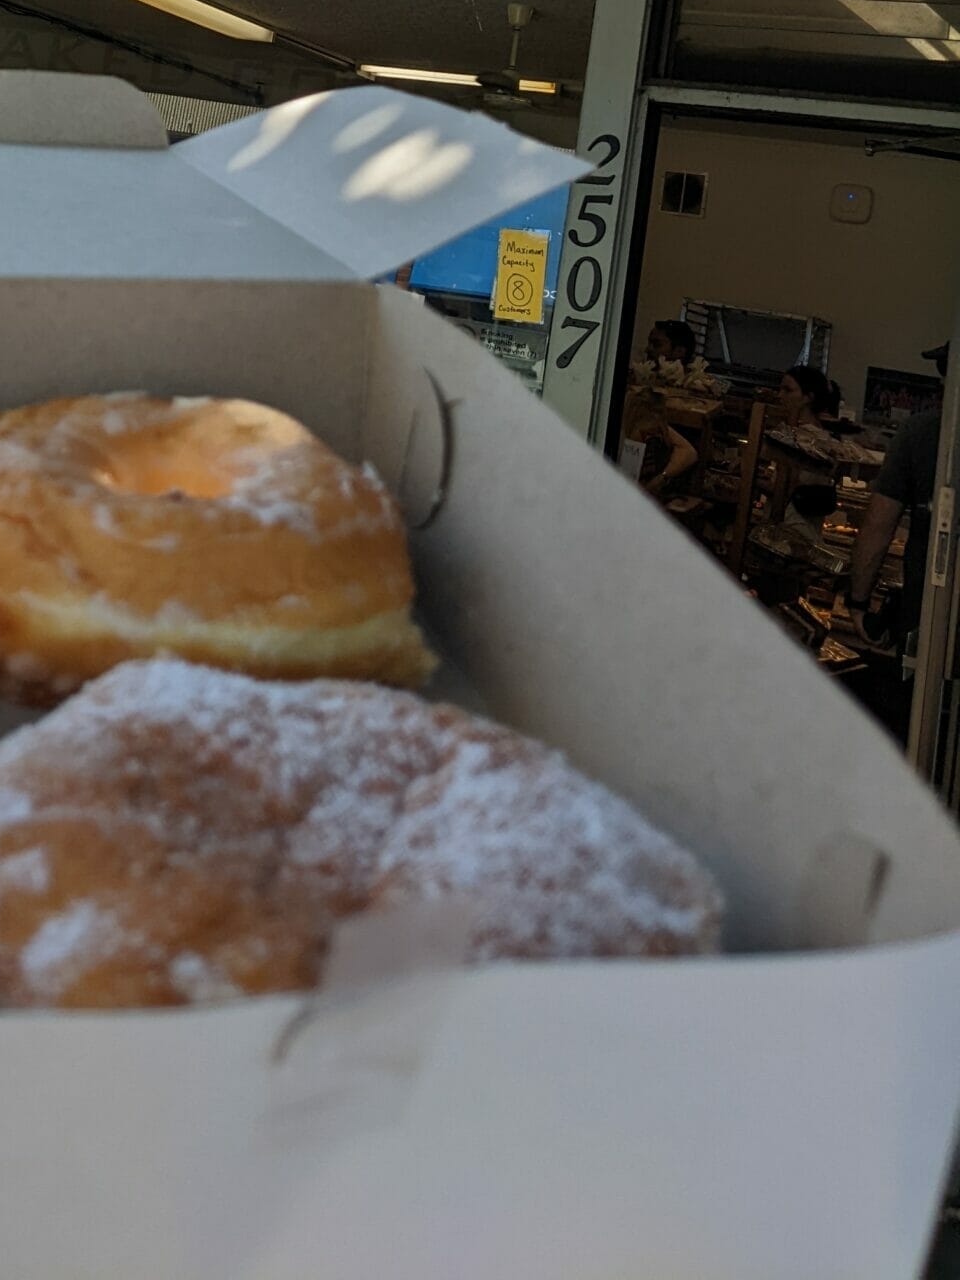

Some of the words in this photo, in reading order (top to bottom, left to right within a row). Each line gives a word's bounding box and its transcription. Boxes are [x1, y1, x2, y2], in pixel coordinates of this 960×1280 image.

[506, 241, 544, 257] Maximum
[556, 134, 621, 369] 2507
[502, 255, 535, 272] Capacity
[513, 281, 525, 300] 8
